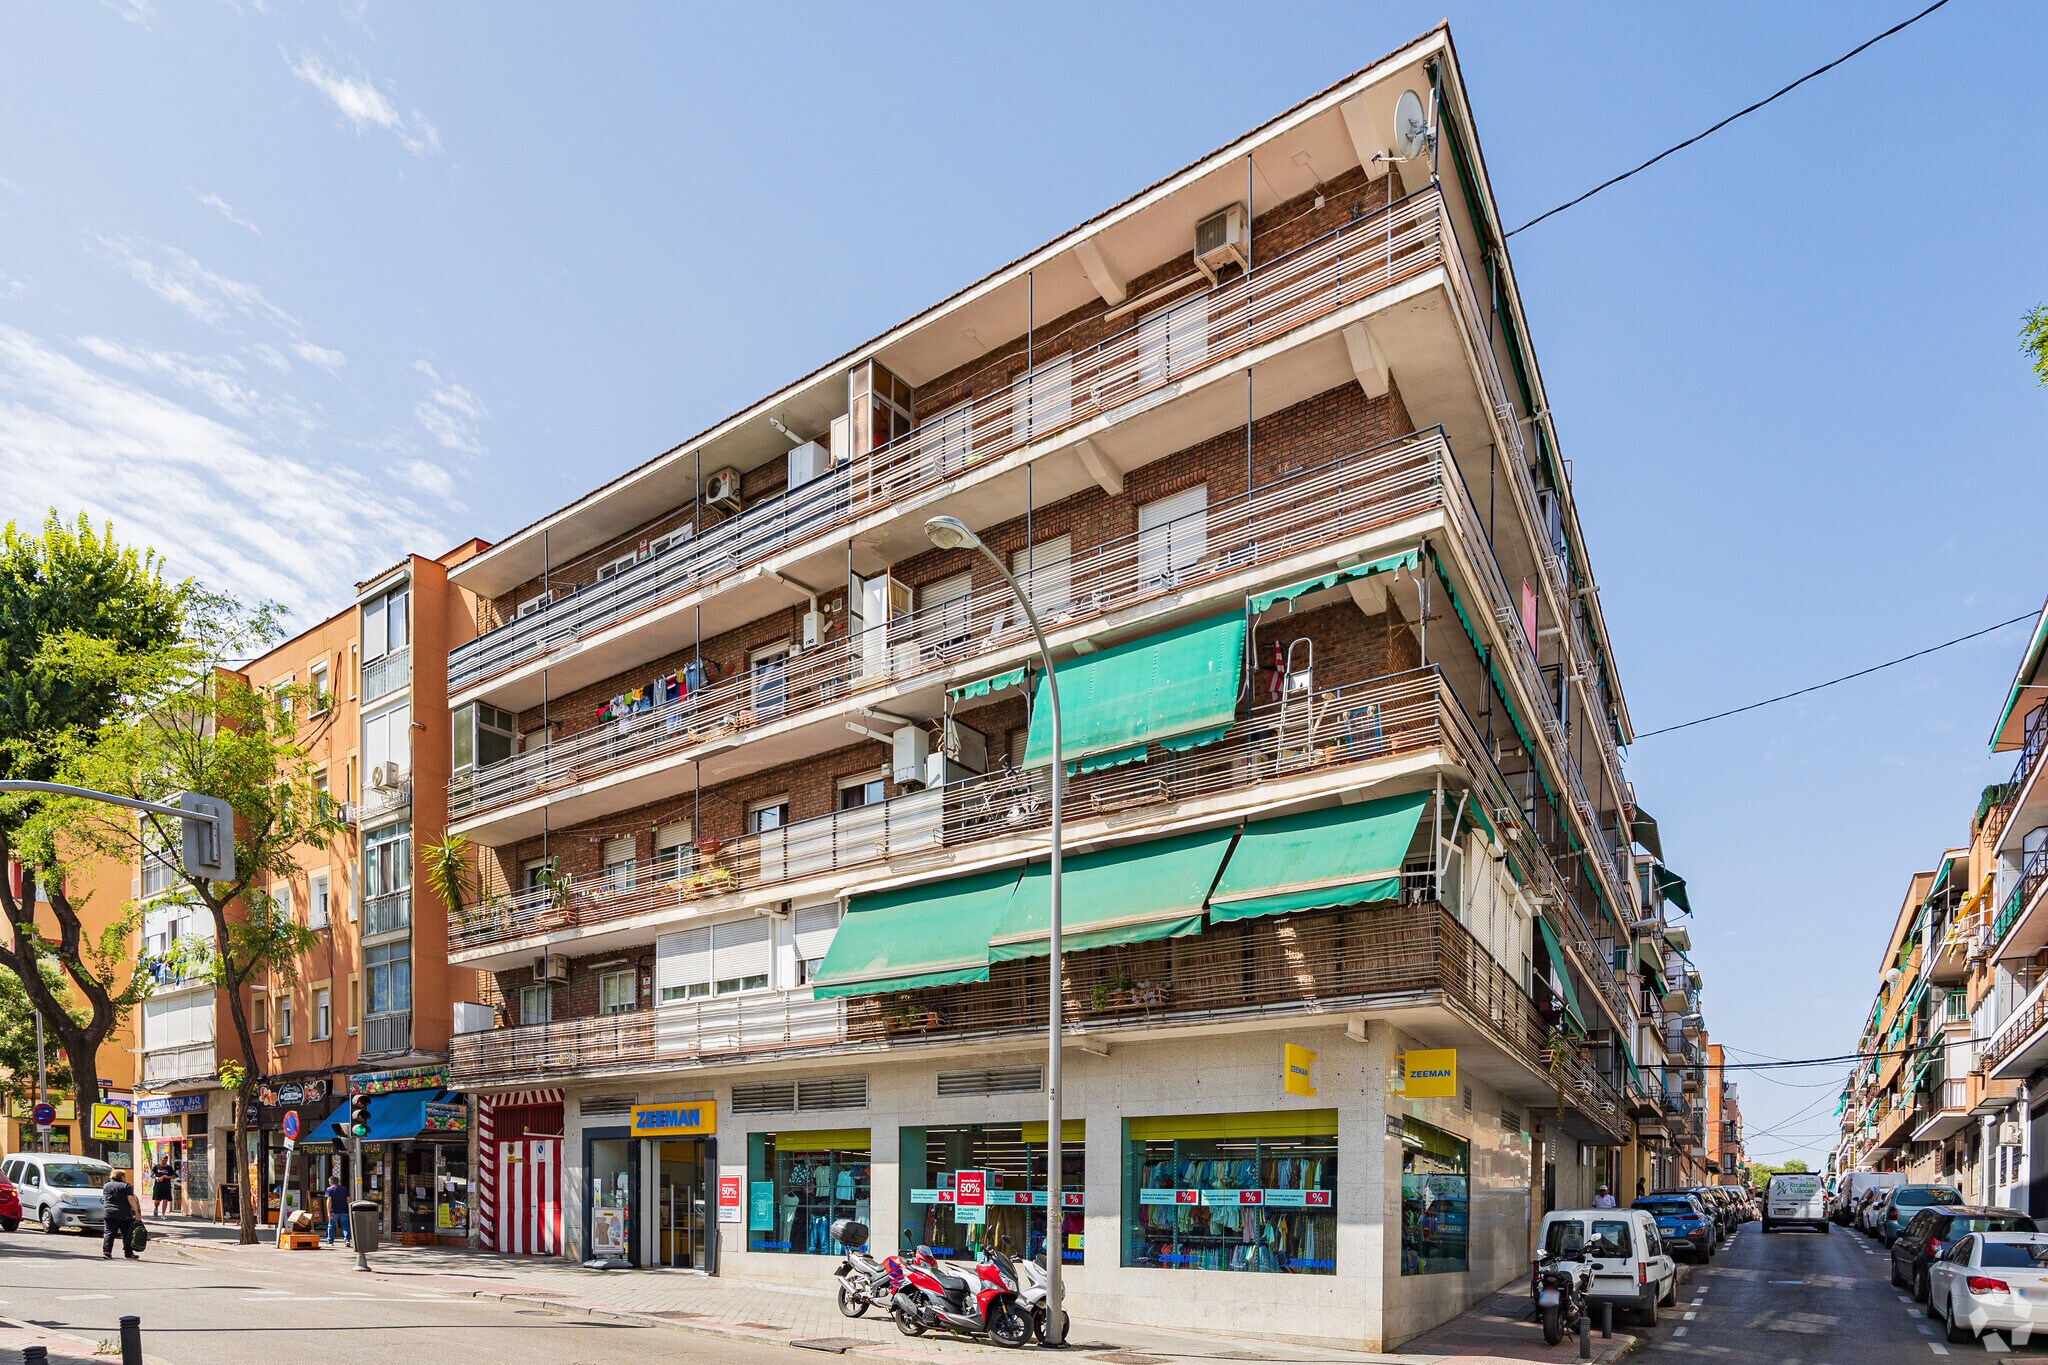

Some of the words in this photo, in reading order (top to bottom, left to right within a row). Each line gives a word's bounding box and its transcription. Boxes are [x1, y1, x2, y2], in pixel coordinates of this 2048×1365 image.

[1290, 1065, 1308, 1076] ZEEMAN
[1410, 1070, 1451, 1078] ZEEMAN
[636, 1108, 700, 1129] ZEEMAN
[722, 1187, 737, 1196] 50%
[960, 1183, 980, 1193] 50%
[1019, 1193, 1028, 1202] %
[1070, 1194, 1079, 1203] %
[1182, 1192, 1192, 1201] %
[1245, 1192, 1256, 1202] %
[1312, 1192, 1323, 1203] %
[1158, 1254, 1199, 1263] ZEEMAN
[1289, 1258, 1335, 1268] ZEEMAN
